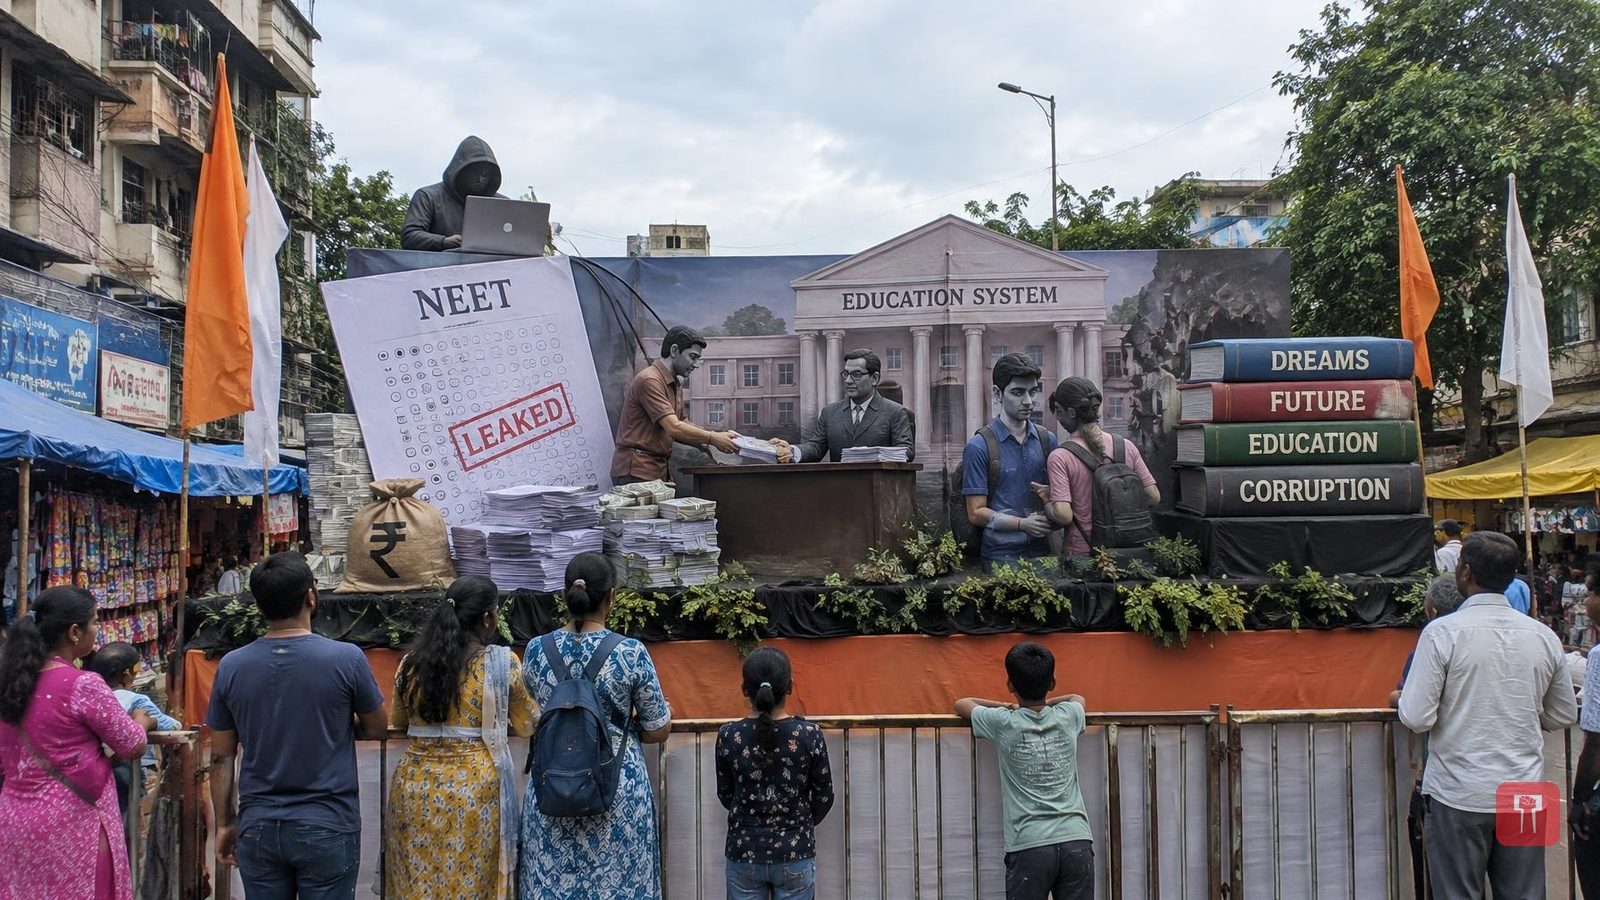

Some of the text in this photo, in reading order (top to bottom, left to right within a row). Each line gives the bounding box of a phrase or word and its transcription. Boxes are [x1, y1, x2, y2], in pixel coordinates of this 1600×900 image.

[413, 279, 511, 319] NEET
[842, 286, 1058, 310] EDUCATION SYSTEM
[1271, 349, 1369, 371] DREAMS
[1270, 390, 1365, 412] FUTURE
[461, 397, 563, 456] LEAKED
[1249, 432, 1378, 455] EDUCATION
[1240, 478, 1390, 502] CORRUPTION
